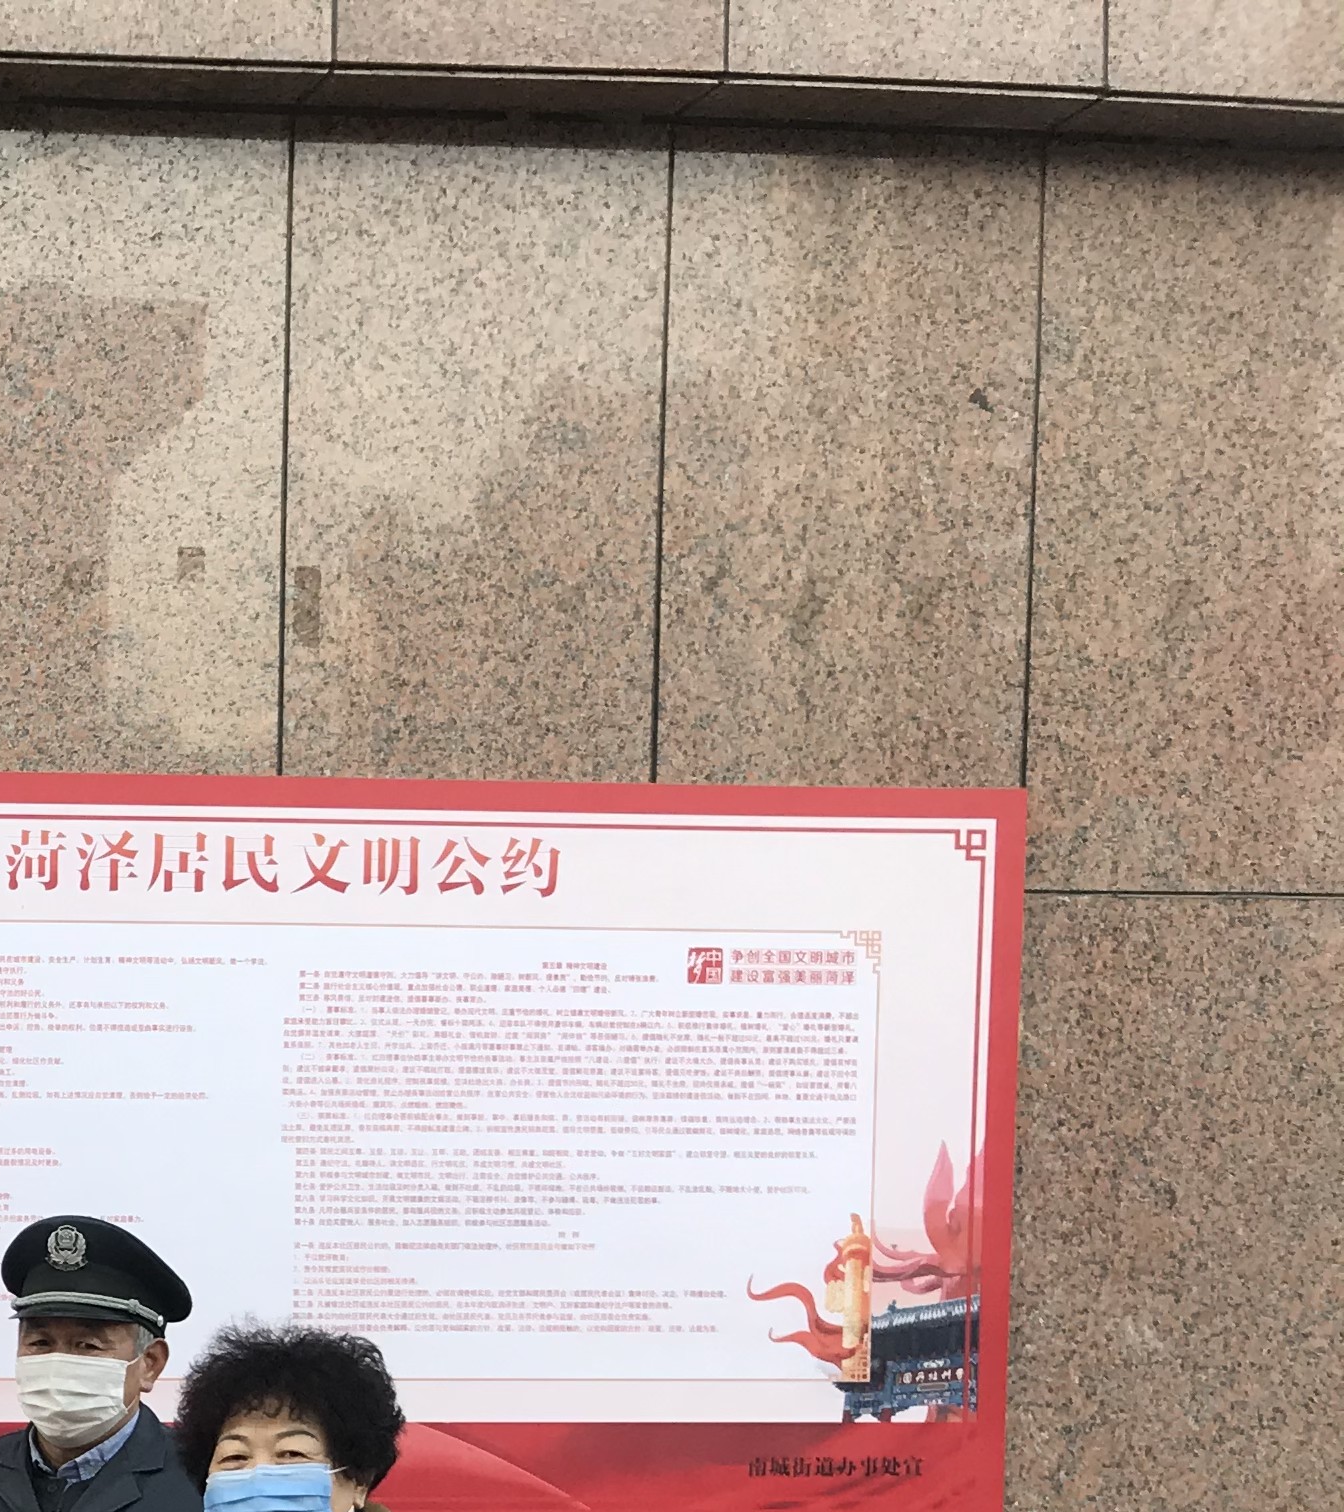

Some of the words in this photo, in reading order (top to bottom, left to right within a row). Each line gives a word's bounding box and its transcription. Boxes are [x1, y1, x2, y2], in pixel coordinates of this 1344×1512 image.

[5, 829, 562, 898] 菏泽居民文明公约
[730, 949, 856, 966] 争创全国文明城市
[730, 968, 856, 985] 建设富强美丽菏泽
[746, 1456, 925, 1479] 南城街道办事处宣
